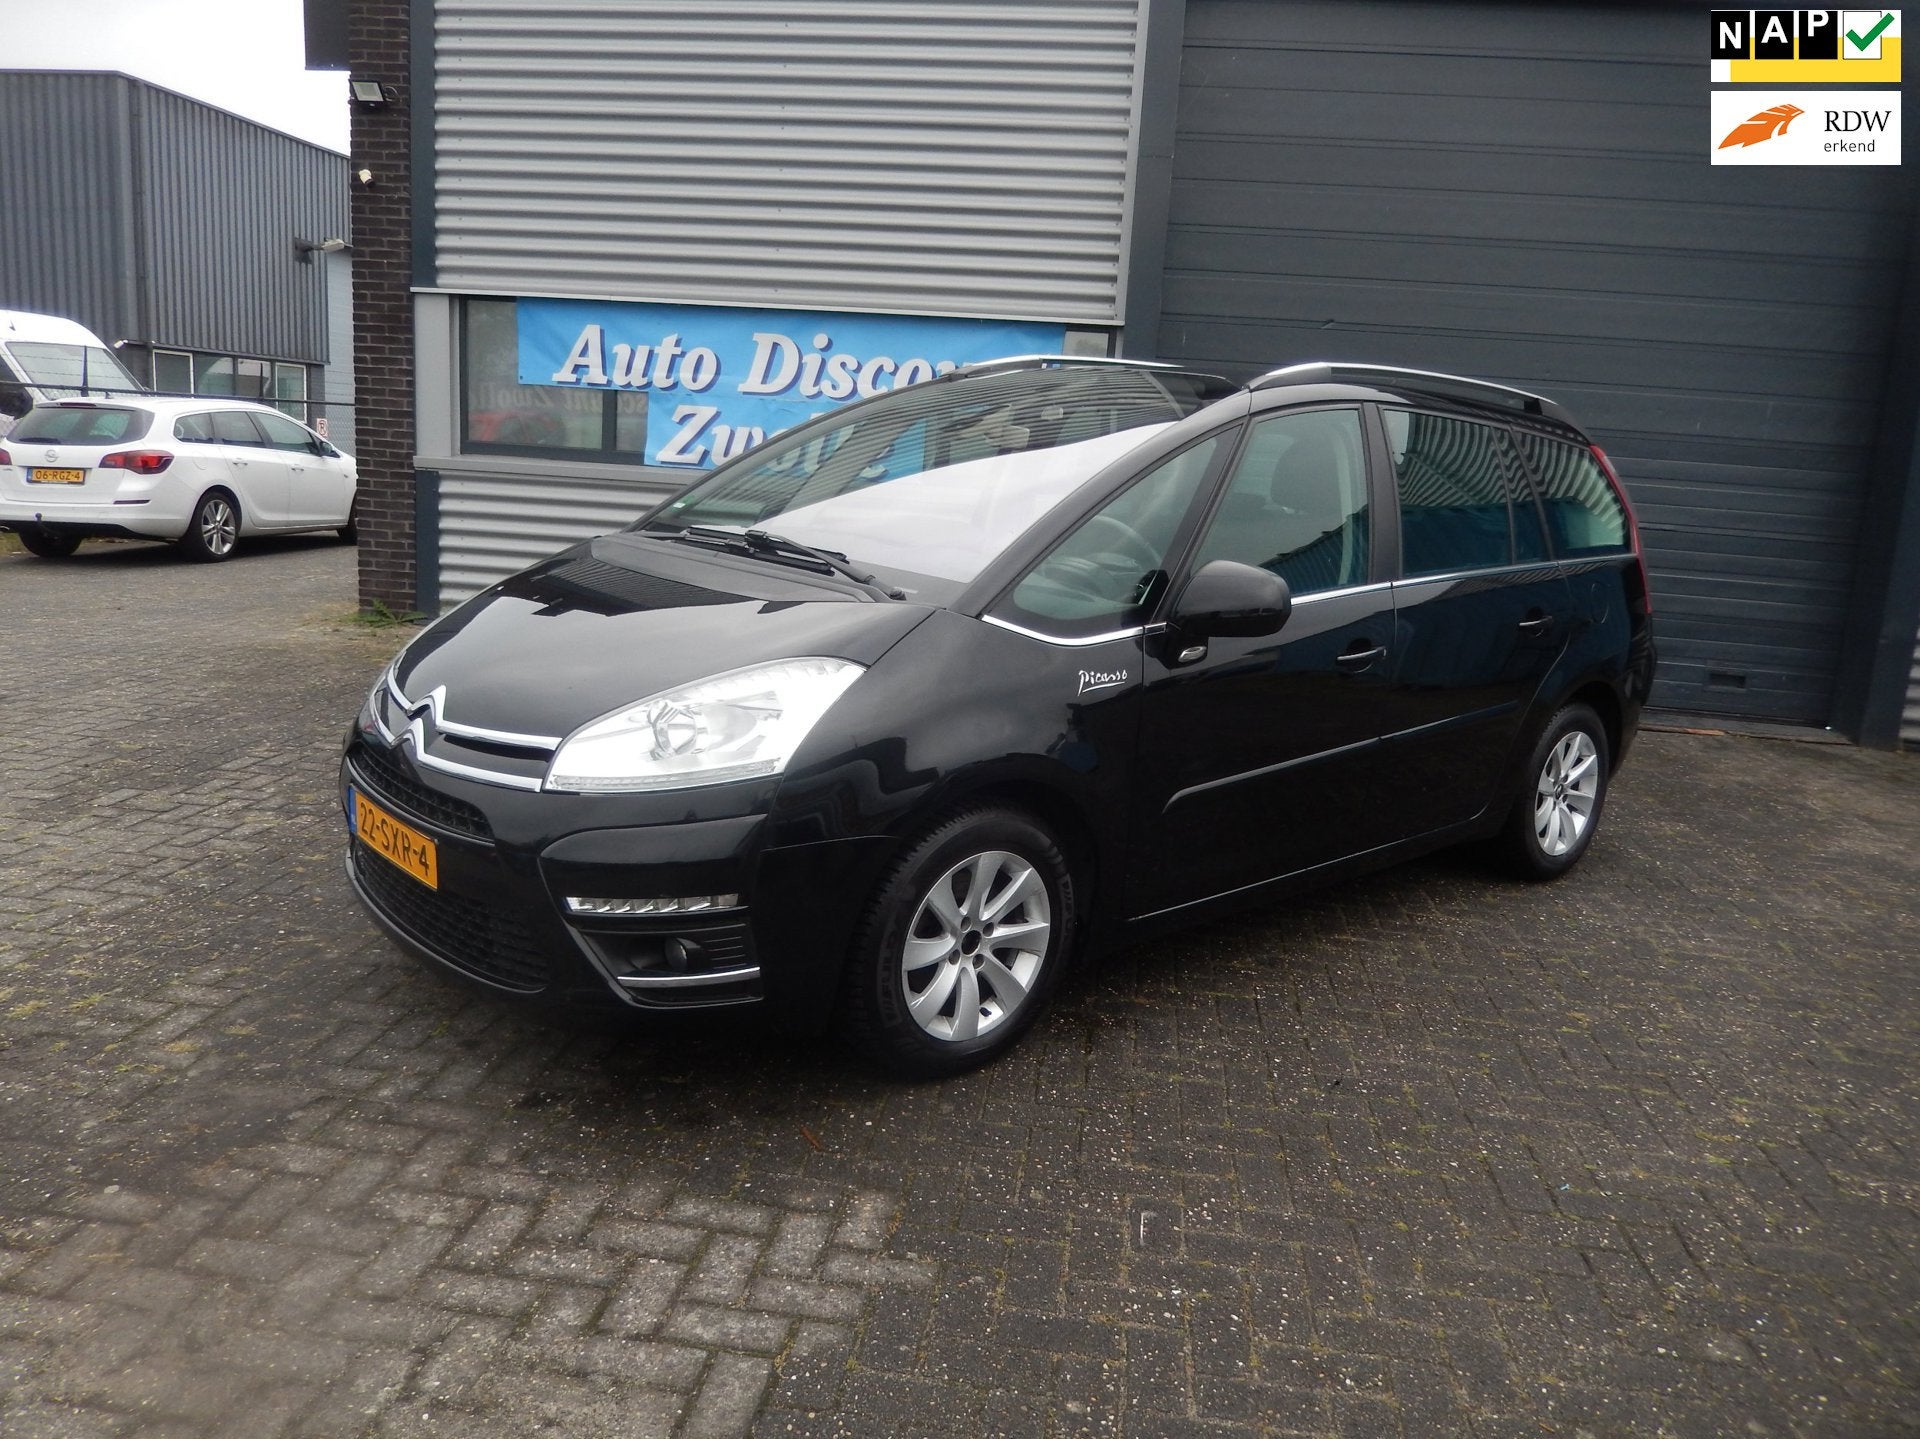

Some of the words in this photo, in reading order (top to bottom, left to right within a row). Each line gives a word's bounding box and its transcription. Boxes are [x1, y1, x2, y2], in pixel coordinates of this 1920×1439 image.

[552, 324, 721, 392] Auto
[738, 332, 974, 400] Disco
[35, 470, 81, 481] 06-RGZ-4
[1077, 669, 1128, 697] Picasso
[360, 801, 430, 877] 22-SXR-4
